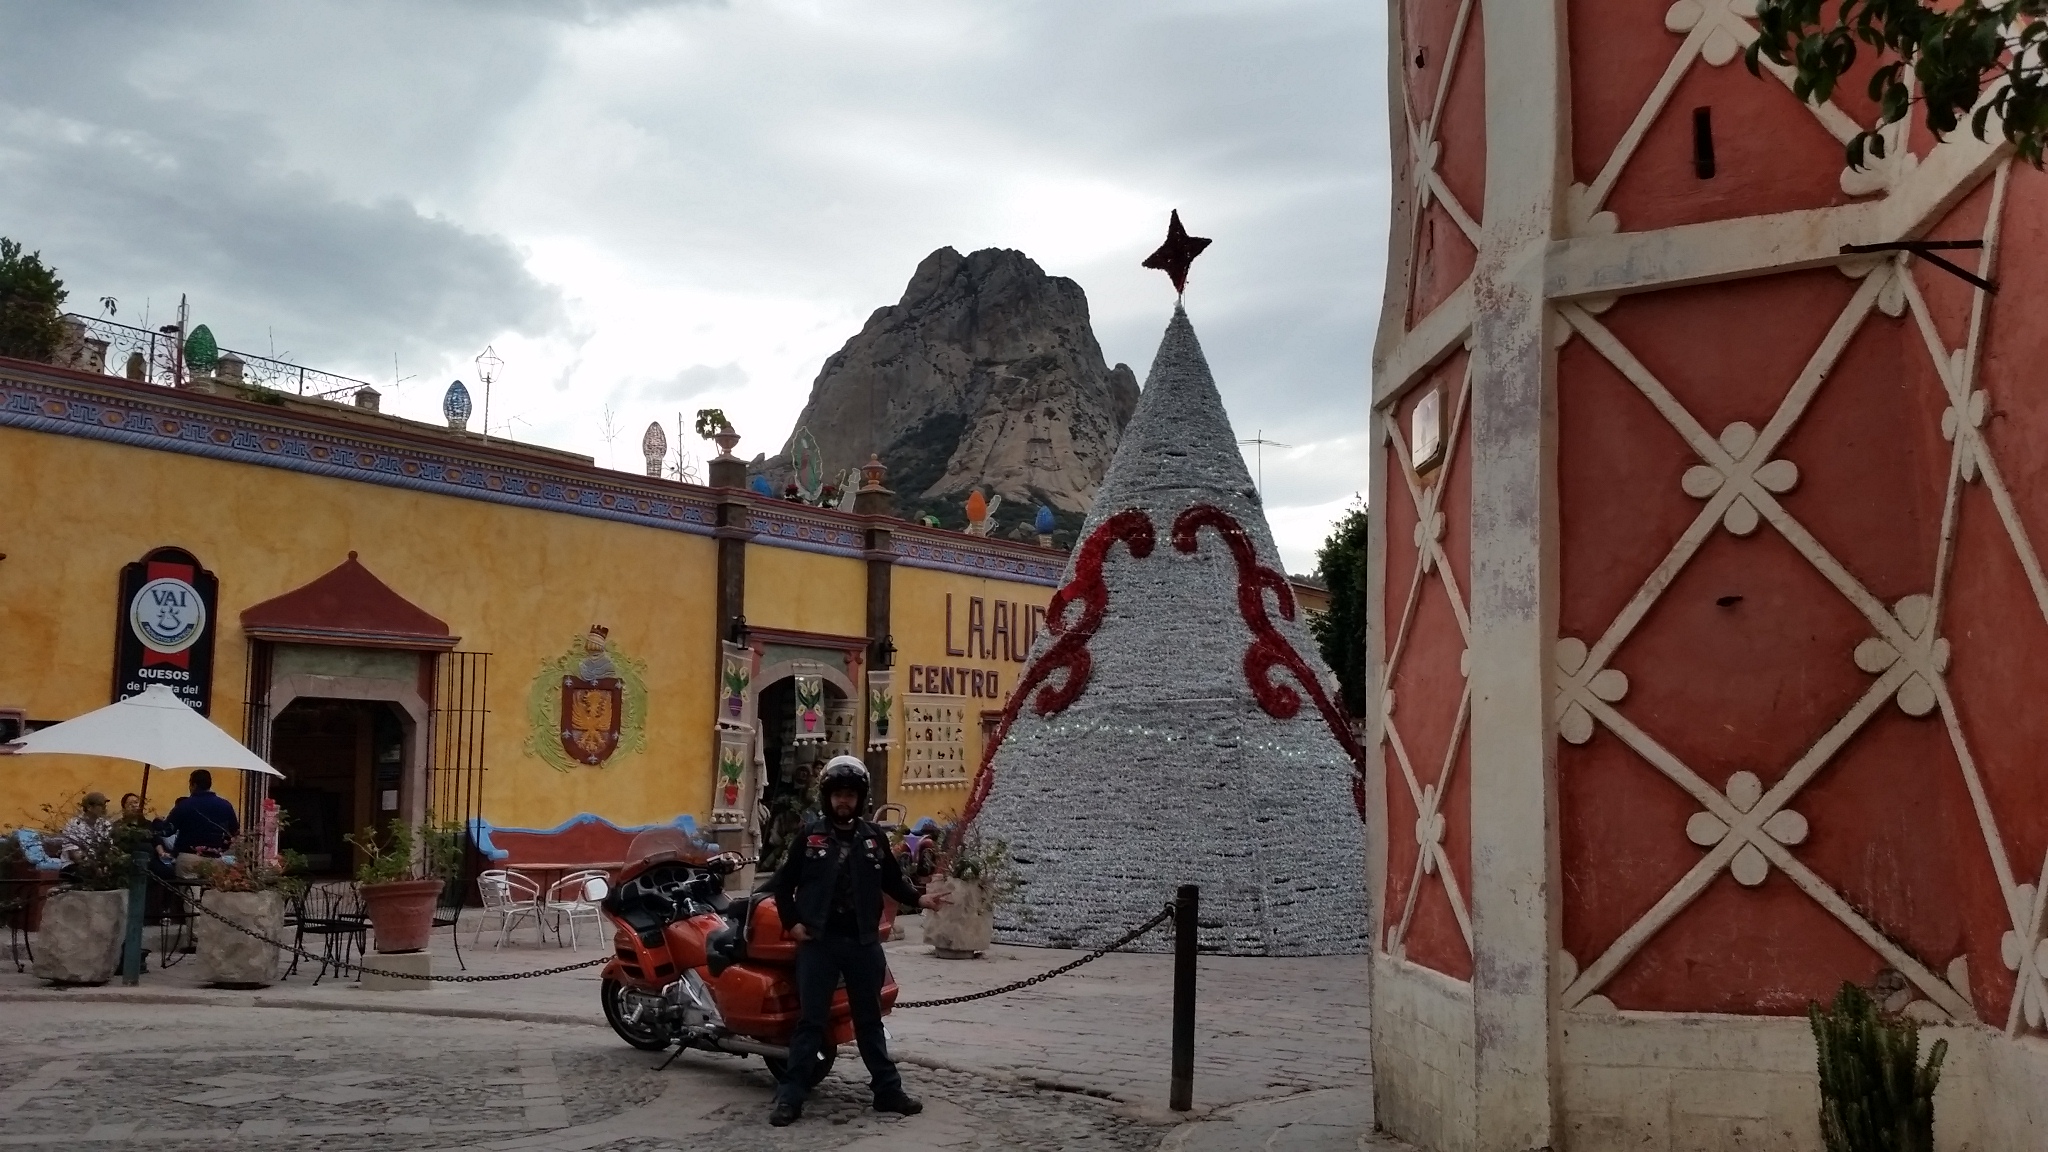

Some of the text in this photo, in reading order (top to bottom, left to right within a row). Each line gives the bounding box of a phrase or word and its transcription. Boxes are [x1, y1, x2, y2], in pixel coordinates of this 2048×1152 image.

[151, 589, 187, 608] VAI
[138, 668, 190, 681] QUESOS
[909, 664, 999, 699] CENTRO
[126, 681, 140, 691] de
[182, 684, 199, 695] del
